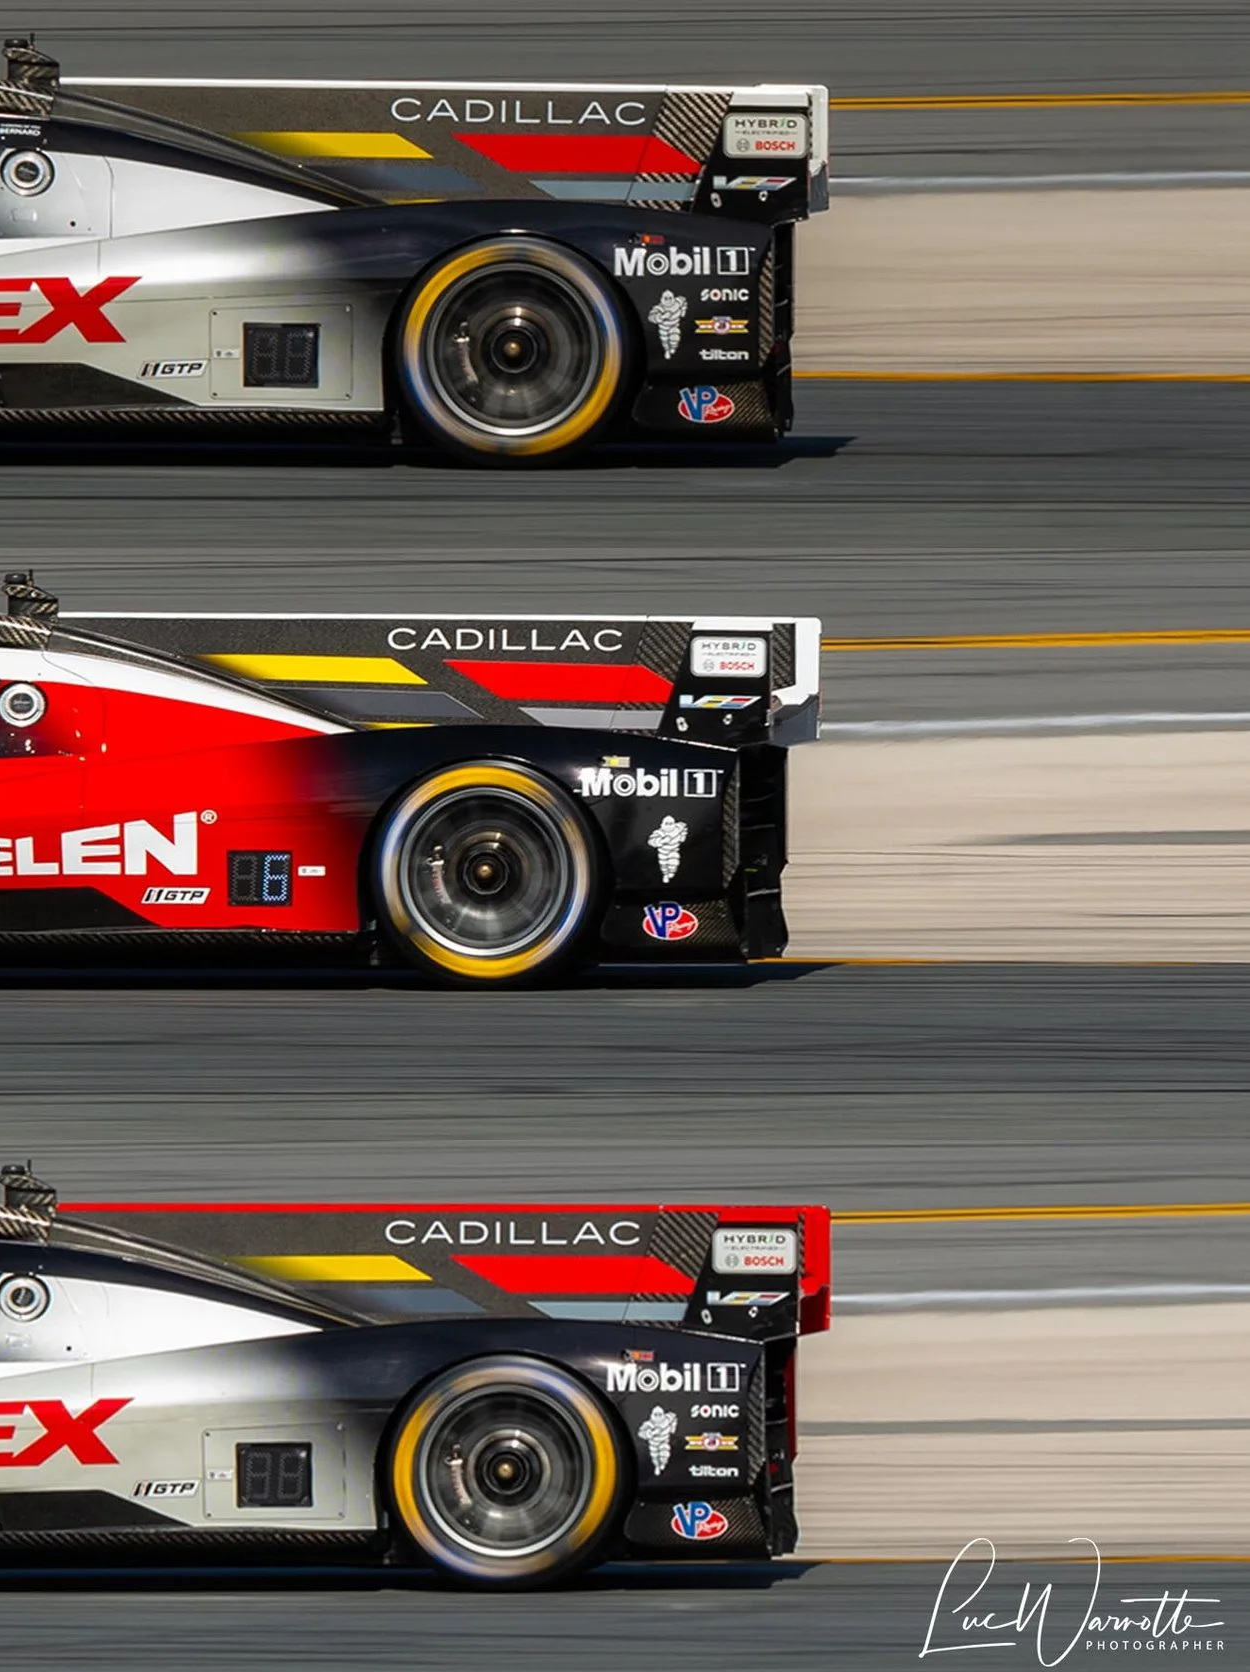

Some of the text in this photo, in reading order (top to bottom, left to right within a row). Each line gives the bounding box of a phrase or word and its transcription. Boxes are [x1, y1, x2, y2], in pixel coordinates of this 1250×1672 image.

[390, 98, 646, 126] CADILLAC
[754, 140, 796, 151] BOSCH
[613, 245, 712, 277] Mobil
[700, 288, 750, 302] sonic
[698, 349, 749, 361] tilton
[160, 362, 203, 375] GTP
[679, 385, 719, 422] VP
[387, 628, 623, 652] CADILLAC
[719, 661, 755, 671] BOSCH
[580, 767, 679, 798] Mobil
[262, 853, 290, 902] 6
[163, 890, 205, 902] GTP
[643, 901, 683, 940] VP
[383, 1220, 641, 1246] CADILLAC
[743, 1255, 785, 1267] BOSCH
[606, 1362, 701, 1392] Mobil
[690, 1404, 740, 1418] sonic
[688, 1465, 739, 1478] tilton
[152, 1482, 196, 1495] GTP
[672, 1501, 713, 1540] VP
